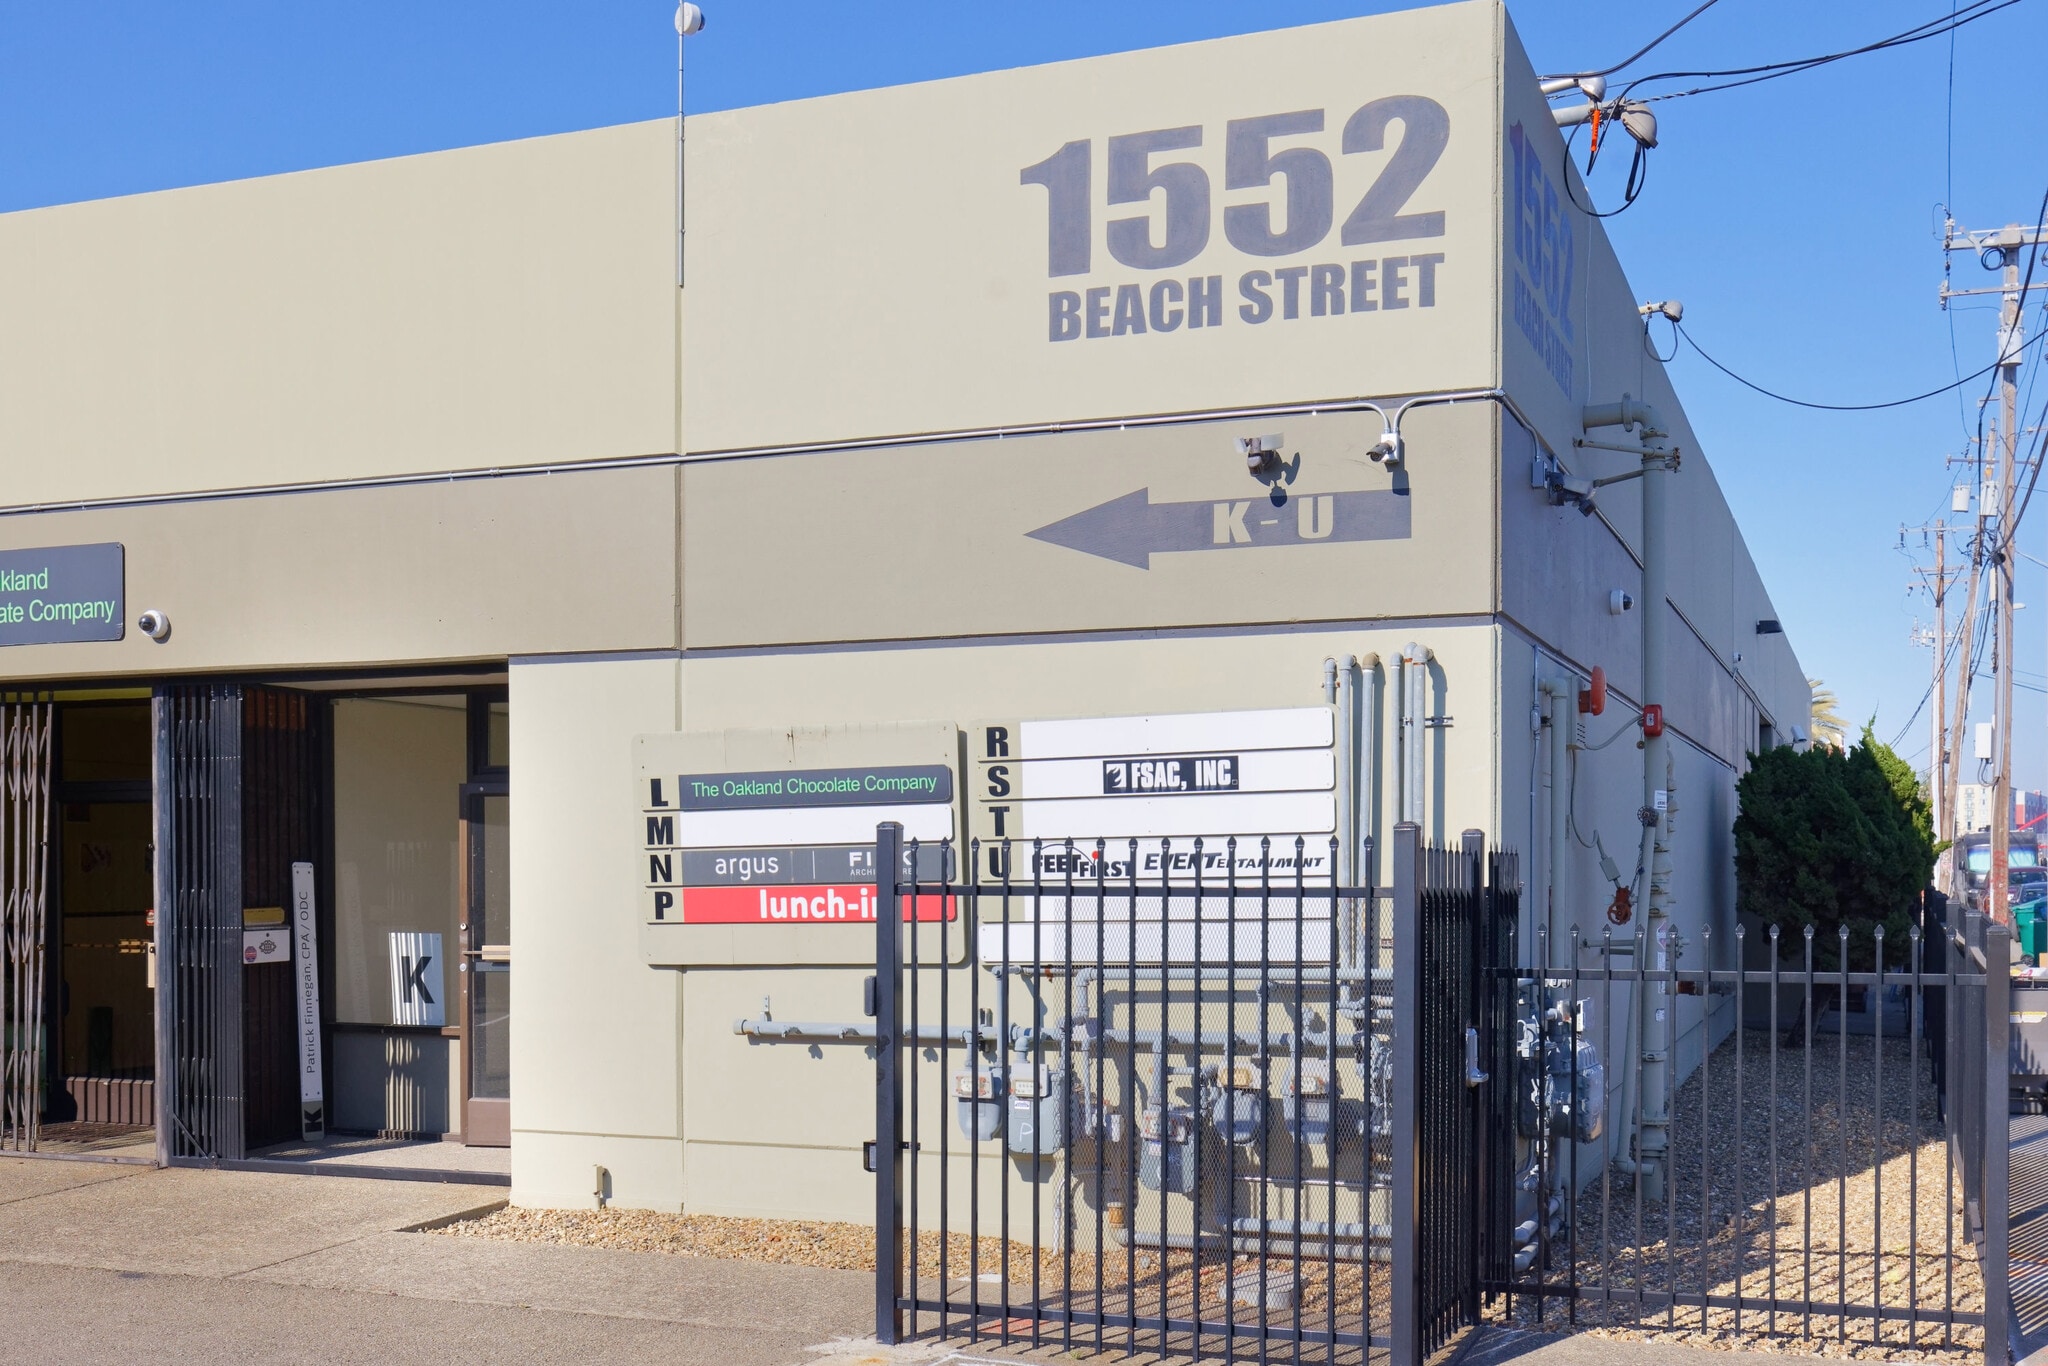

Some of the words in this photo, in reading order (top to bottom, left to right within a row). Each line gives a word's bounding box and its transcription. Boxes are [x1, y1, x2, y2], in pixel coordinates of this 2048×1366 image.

[1020, 94, 1450, 277] 1552
[1509, 119, 1574, 346] 1552
[1048, 275, 1223, 342] BEACH
[1238, 252, 1446, 326] STREET
[1514, 268, 1544, 358] BEACH
[1545, 319, 1573, 400] STREET
[1213, 501, 1252, 543] K
[1298, 496, 1334, 540] U
[0, 567, 48, 592] kland
[29, 599, 115, 625] Company
[986, 727, 1009, 757] R
[650, 778, 669, 807] L
[691, 781, 719, 797] The
[723, 779, 783, 796] Oakland
[787, 776, 860, 794] Chocolate
[864, 775, 937, 794] Company
[988, 766, 1010, 797] S
[1131, 761, 1187, 791] FSAC,
[647, 816, 674, 845] M
[989, 806, 1010, 837] T
[650, 854, 673, 883] N
[715, 856, 780, 881] argus
[849, 850, 912, 867] FIK
[850, 867, 912, 877] ARCHIRE
[989, 847, 1011, 878] U
[299, 891, 309, 921] ODC
[654, 891, 674, 920] P
[301, 933, 311, 960] CPA
[303, 962, 314, 1025] Finnegan,
[401, 956, 436, 1004] K
[305, 1028, 316, 1074] Patrick
[303, 1107, 323, 1133] K
